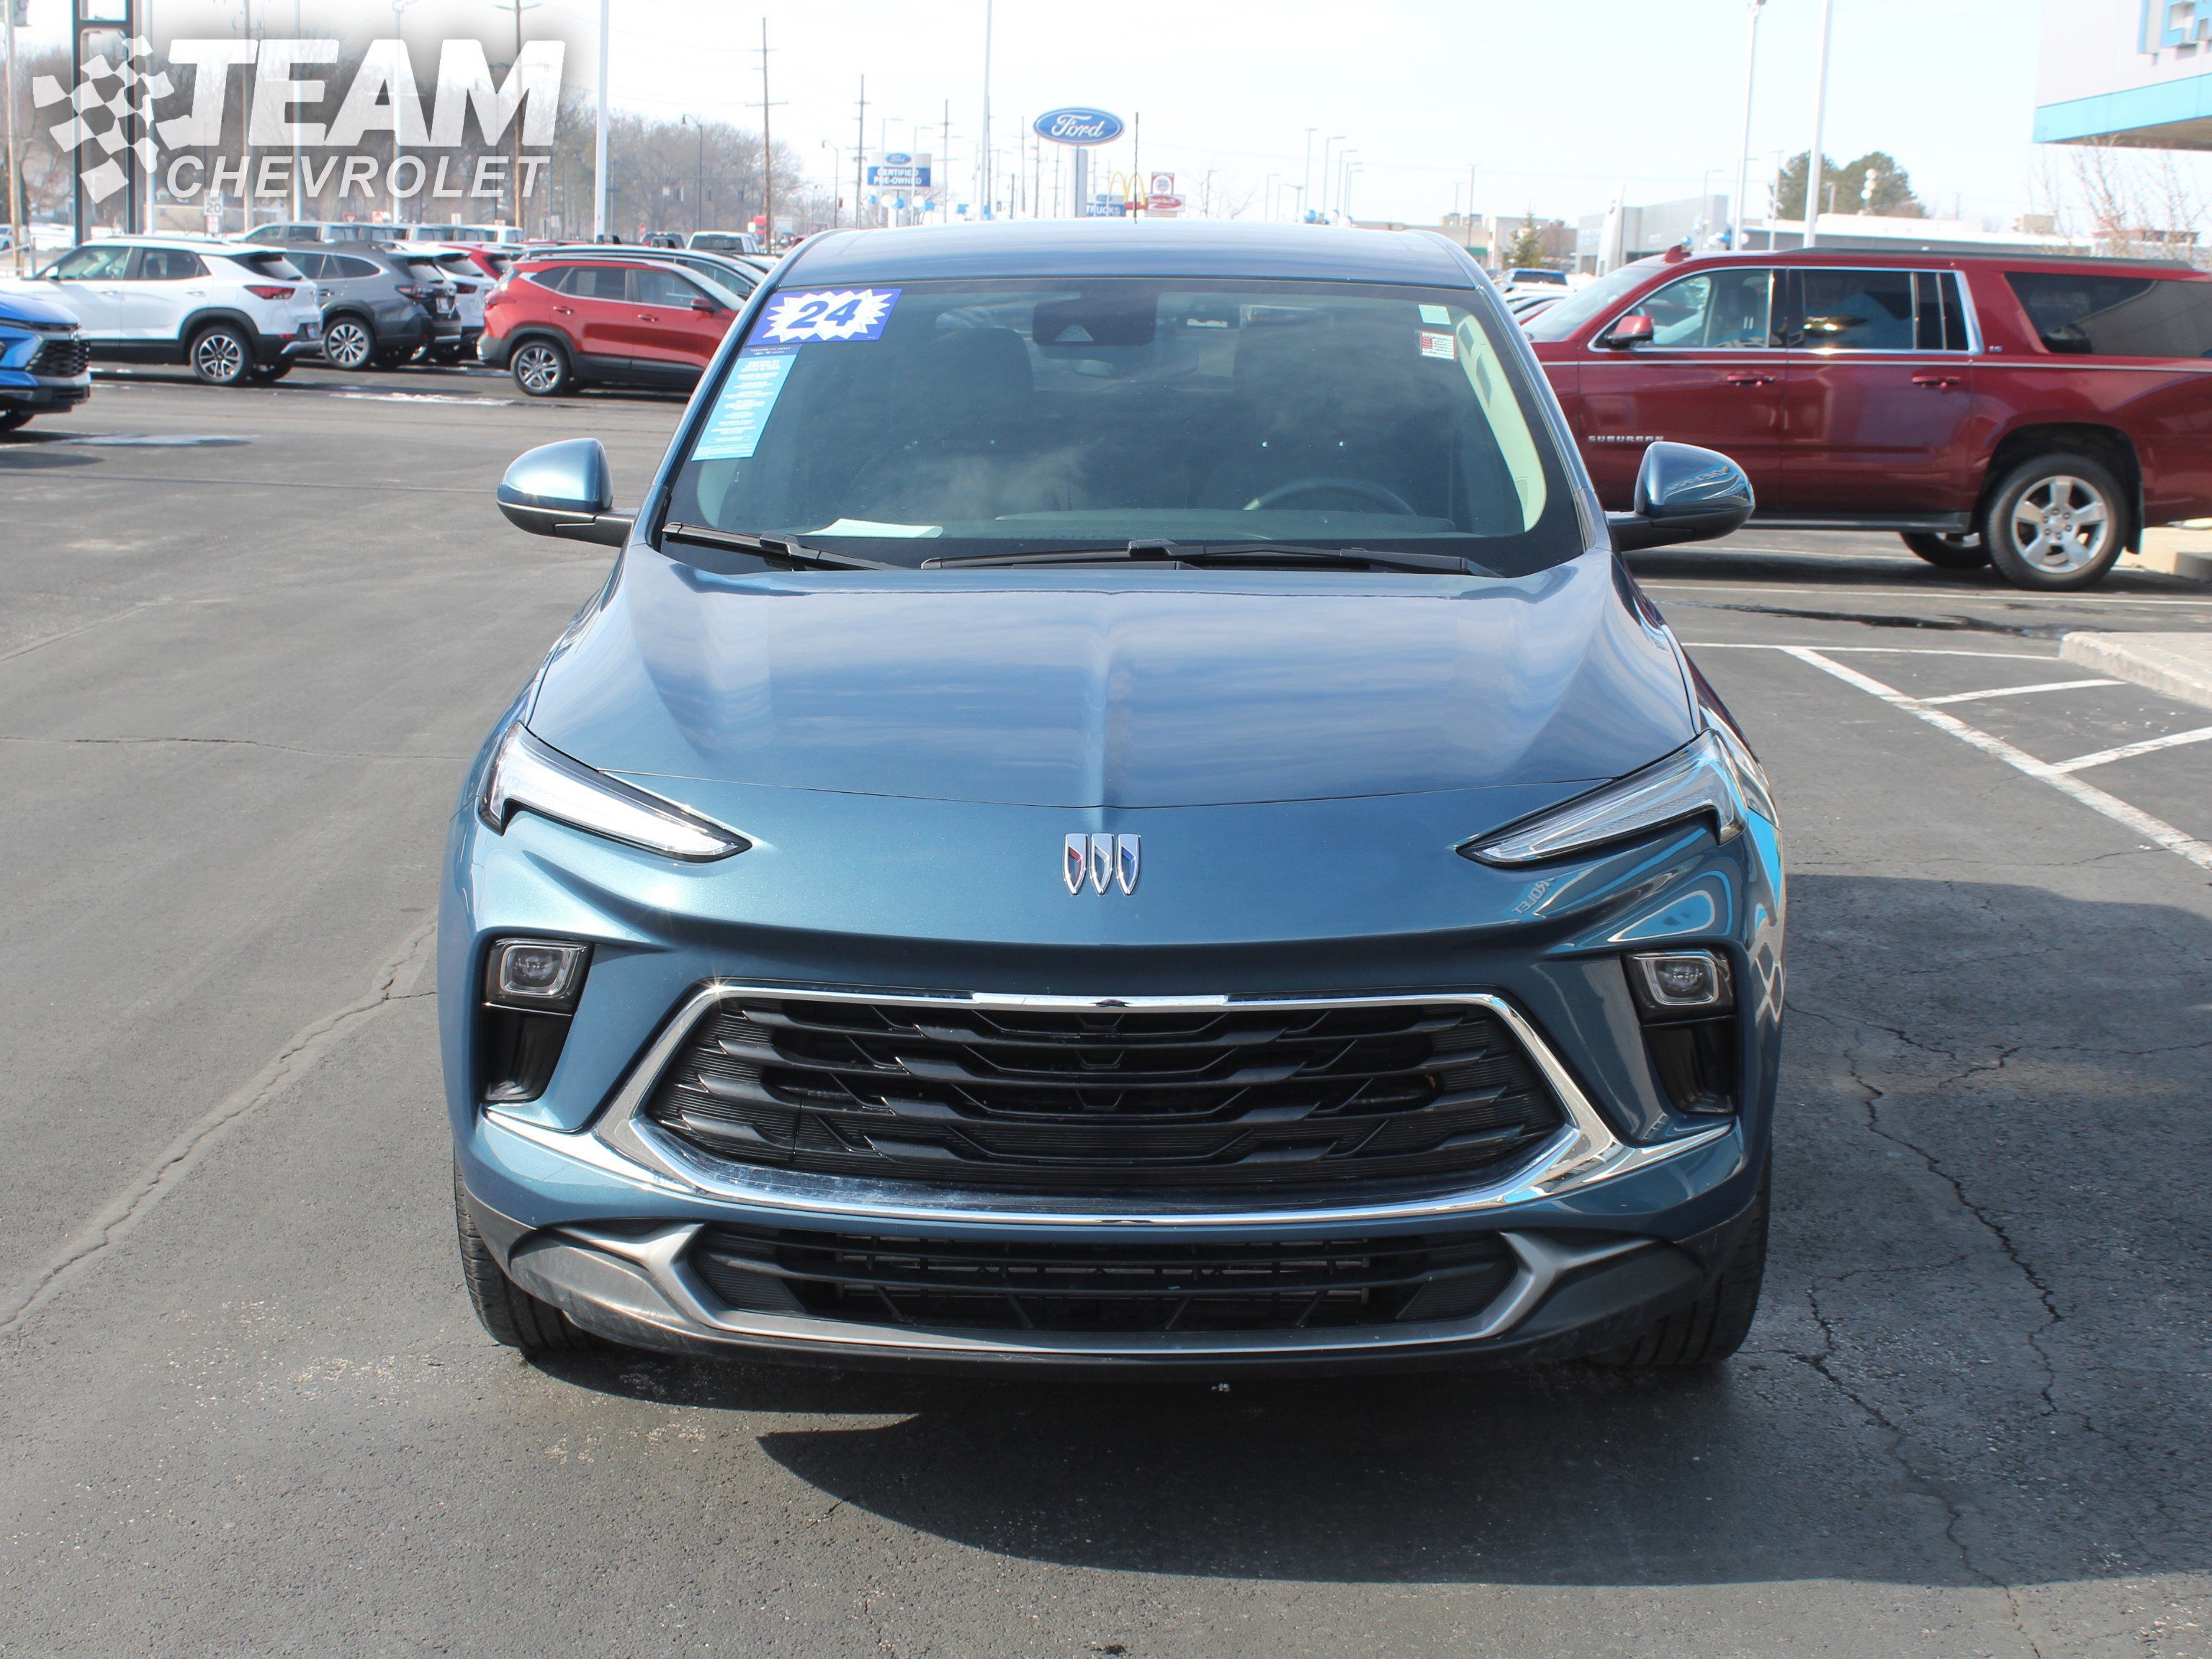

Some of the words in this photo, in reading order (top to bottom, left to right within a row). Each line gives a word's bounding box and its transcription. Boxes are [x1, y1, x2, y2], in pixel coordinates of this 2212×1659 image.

[1051, 113, 1105, 138] Ford
[206, 202, 221, 213] 20
[786, 298, 863, 330] 24
